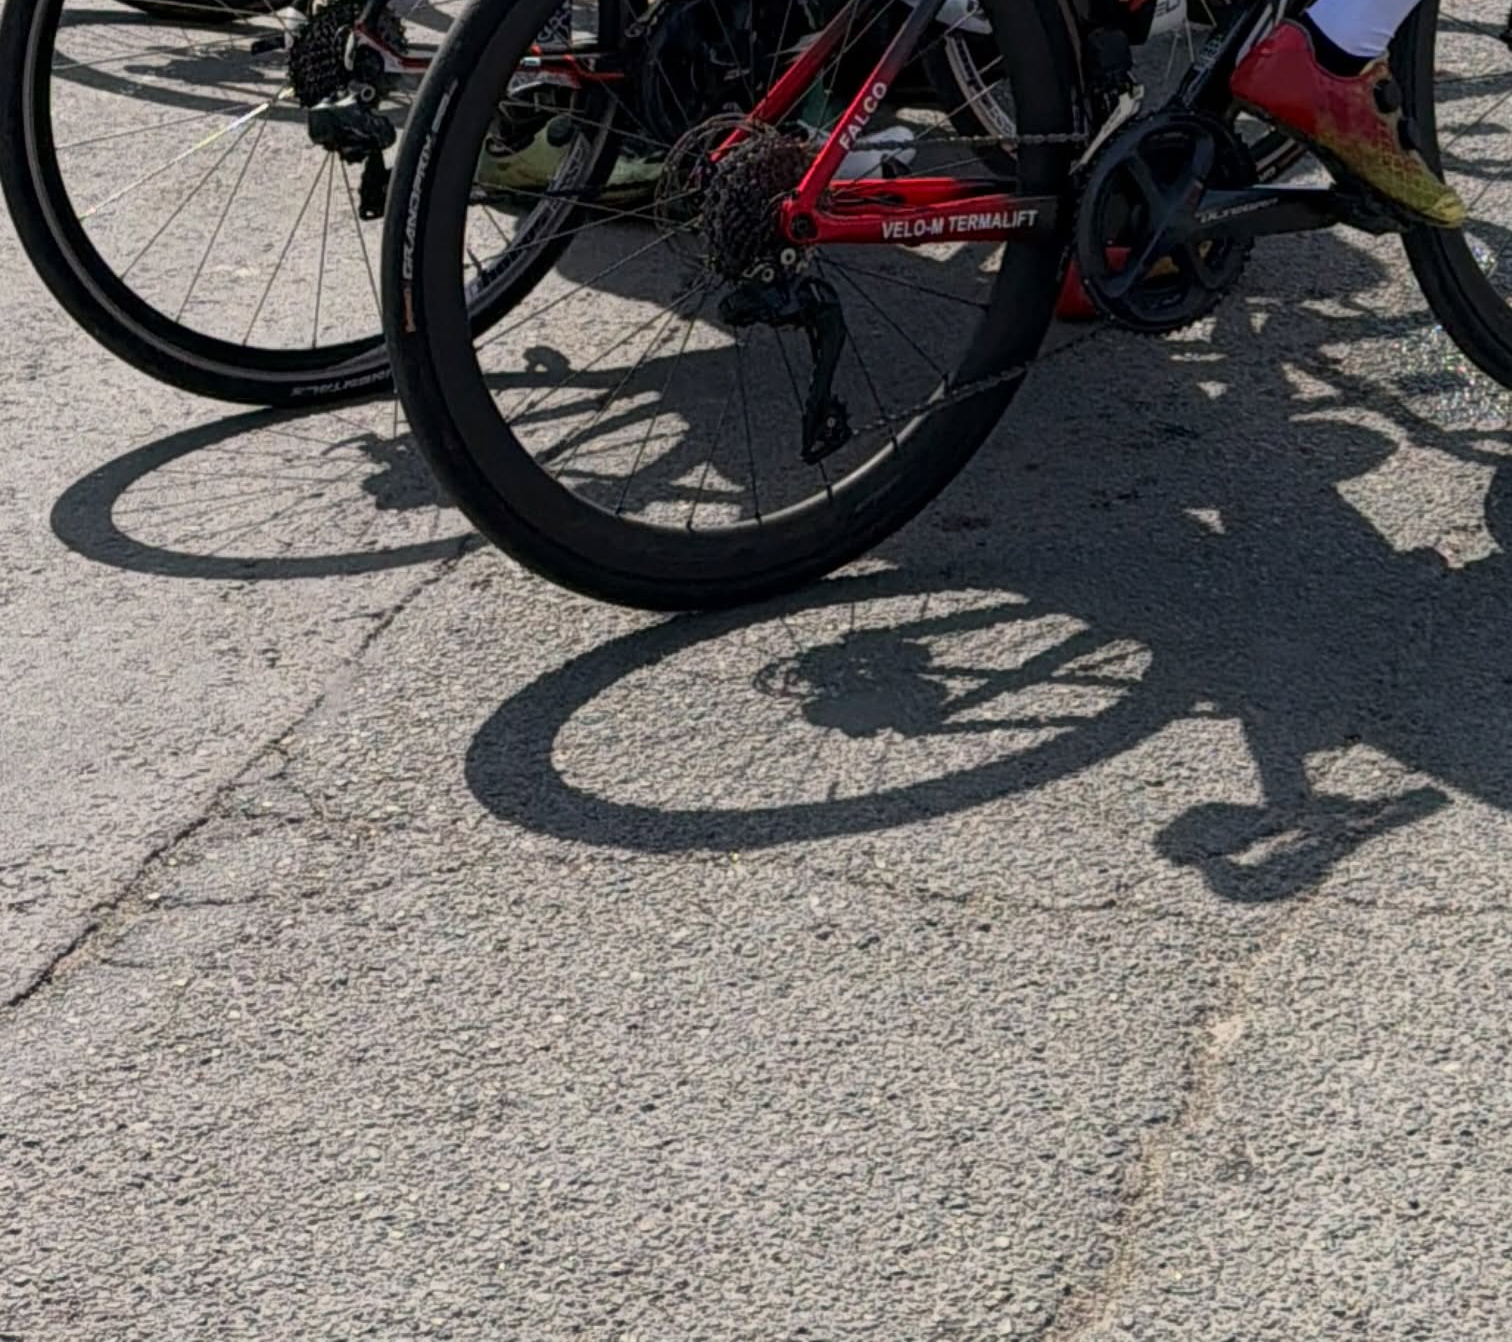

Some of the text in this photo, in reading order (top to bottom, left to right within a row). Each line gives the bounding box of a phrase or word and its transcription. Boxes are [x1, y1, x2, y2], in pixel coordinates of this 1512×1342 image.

[839, 82, 888, 150] FALCO
[882, 210, 1038, 240] VELO-M TERMALIFT
